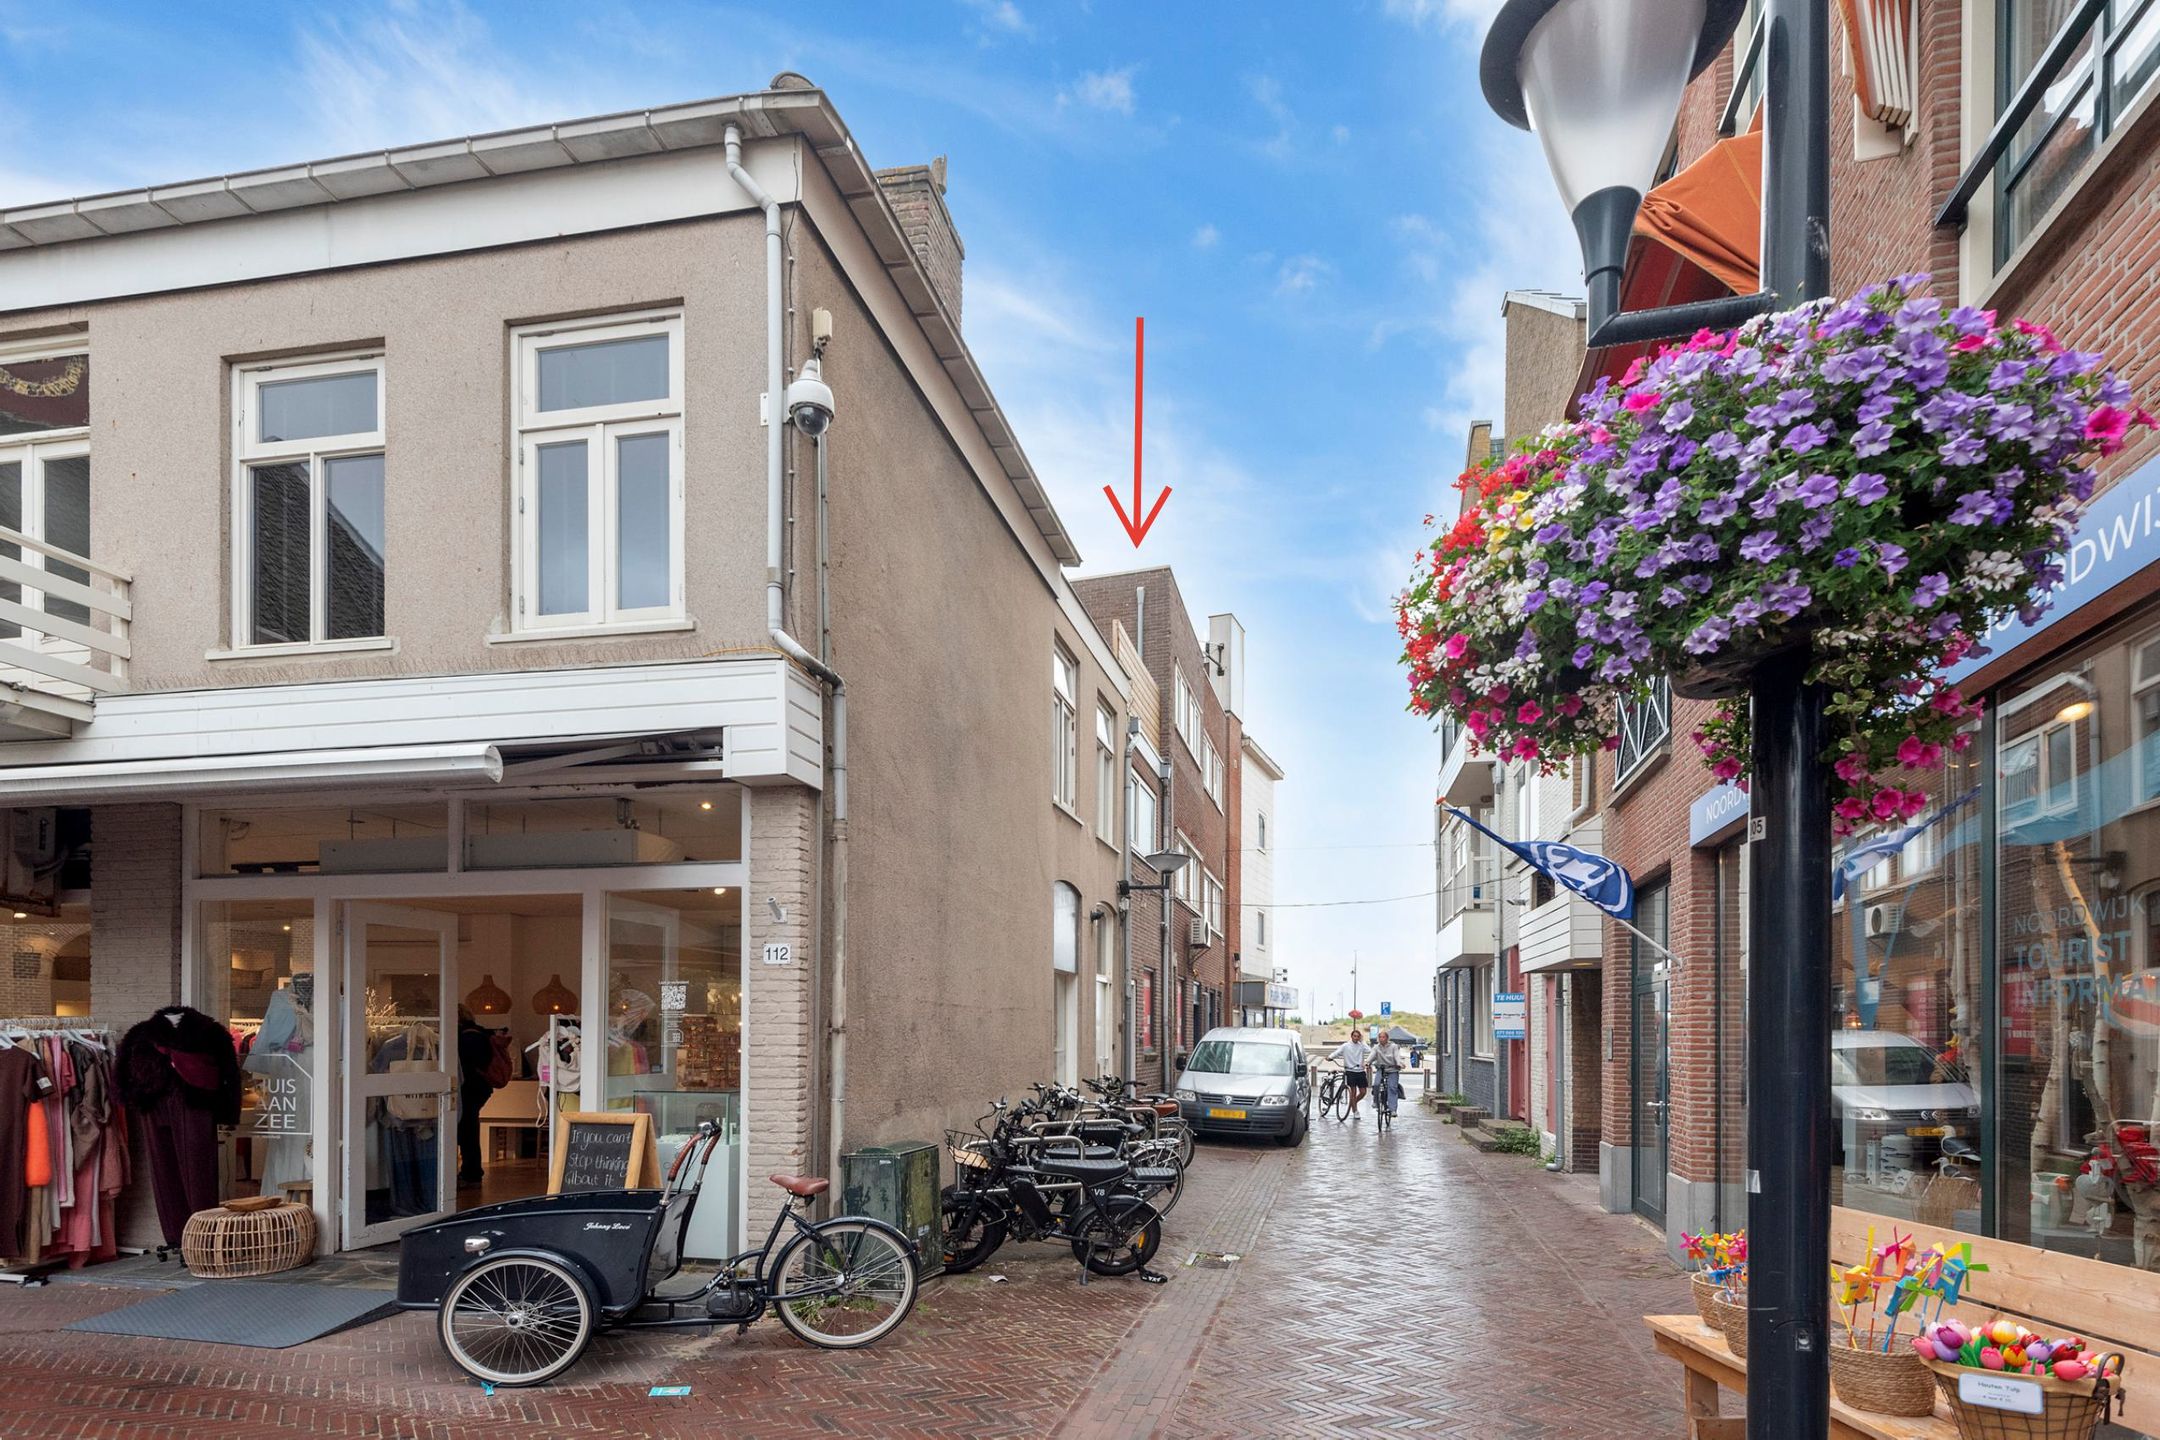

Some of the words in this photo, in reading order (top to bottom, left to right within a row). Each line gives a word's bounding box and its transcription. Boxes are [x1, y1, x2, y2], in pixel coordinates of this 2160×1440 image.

[1706, 786, 1746, 825] NOORD
[2014, 892, 2145, 936] NOORDWIJK
[765, 946, 789, 961] 112
[2013, 929, 2133, 972] TOURIST
[2014, 972, 2160, 1008] INFORMA
[256, 1096, 297, 1111] AAN
[254, 1113, 297, 1129] ZEE
[583, 1131, 604, 1150] you
[1094, 1188, 1106, 1196] V8
[583, 1222, 611, 1231] Johnny
